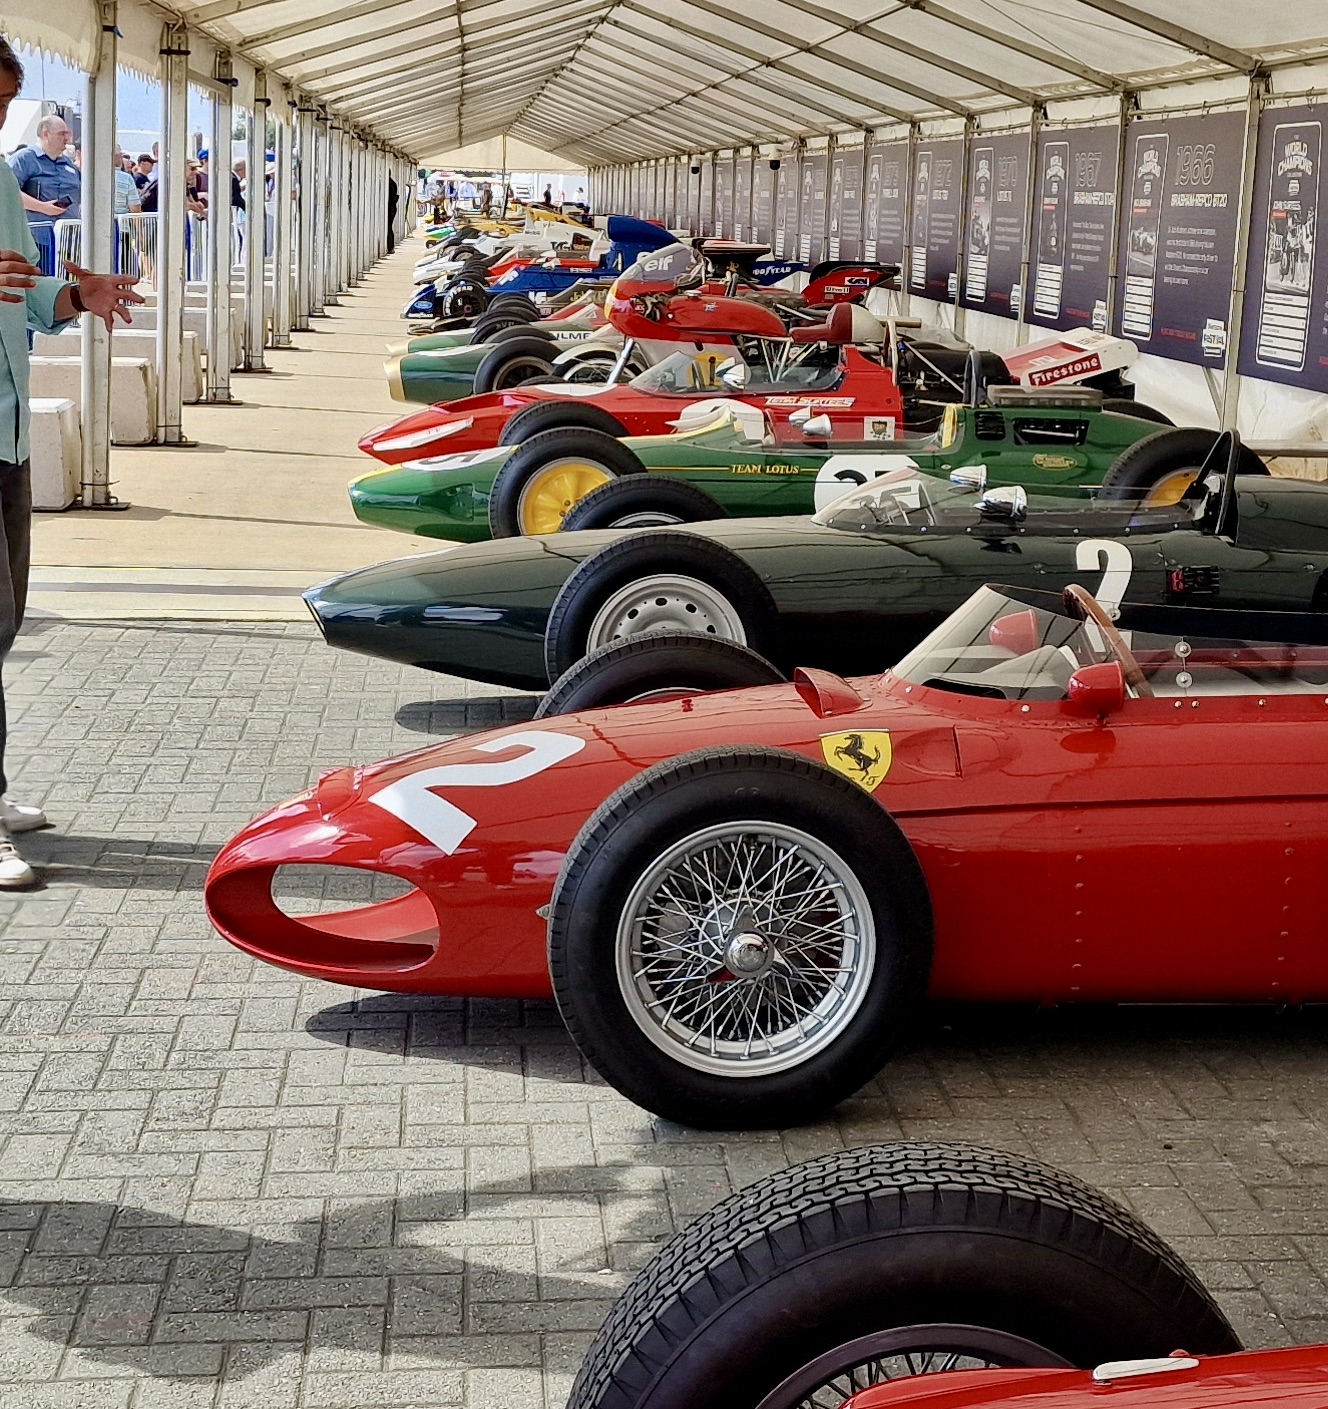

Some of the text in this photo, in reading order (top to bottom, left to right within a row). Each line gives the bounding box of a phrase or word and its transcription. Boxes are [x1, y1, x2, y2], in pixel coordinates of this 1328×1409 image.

[645, 255, 674, 271] elf
[1032, 357, 1099, 386] Firestone
[731, 465, 799, 475] TEAM LOTUS
[1076, 540, 1132, 652] 2
[368, 730, 586, 856] 2
